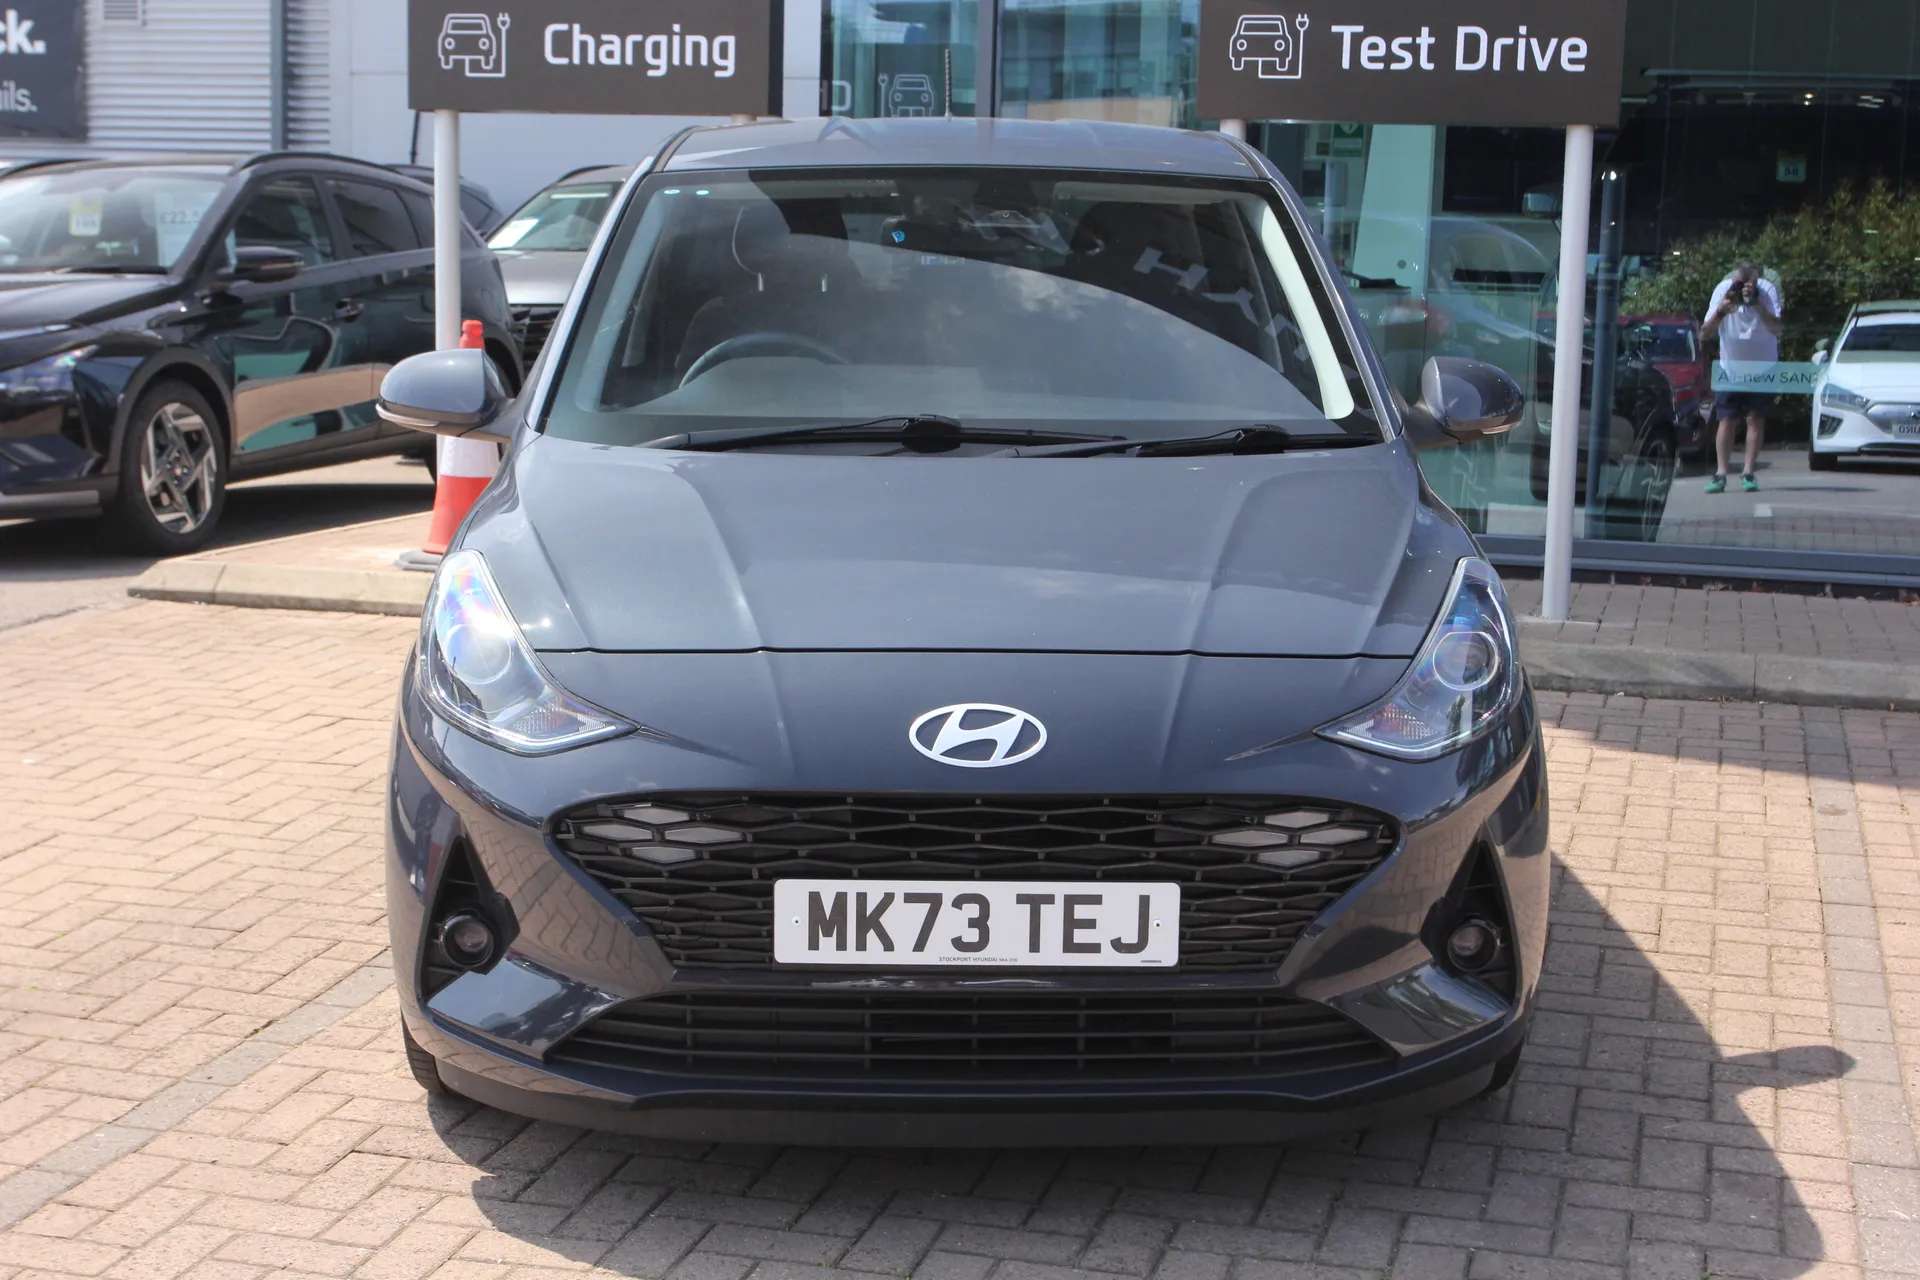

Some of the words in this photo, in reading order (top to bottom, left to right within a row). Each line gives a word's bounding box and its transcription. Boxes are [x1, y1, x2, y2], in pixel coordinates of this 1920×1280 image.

[0, 9, 47, 55] k.
[543, 23, 736, 77] Charging
[1331, 25, 1436, 71] Test
[1455, 25, 1588, 72] Drive
[0, 80, 38, 112] ils.
[807, 891, 990, 953] MK73
[1016, 894, 1151, 954] TEJ
